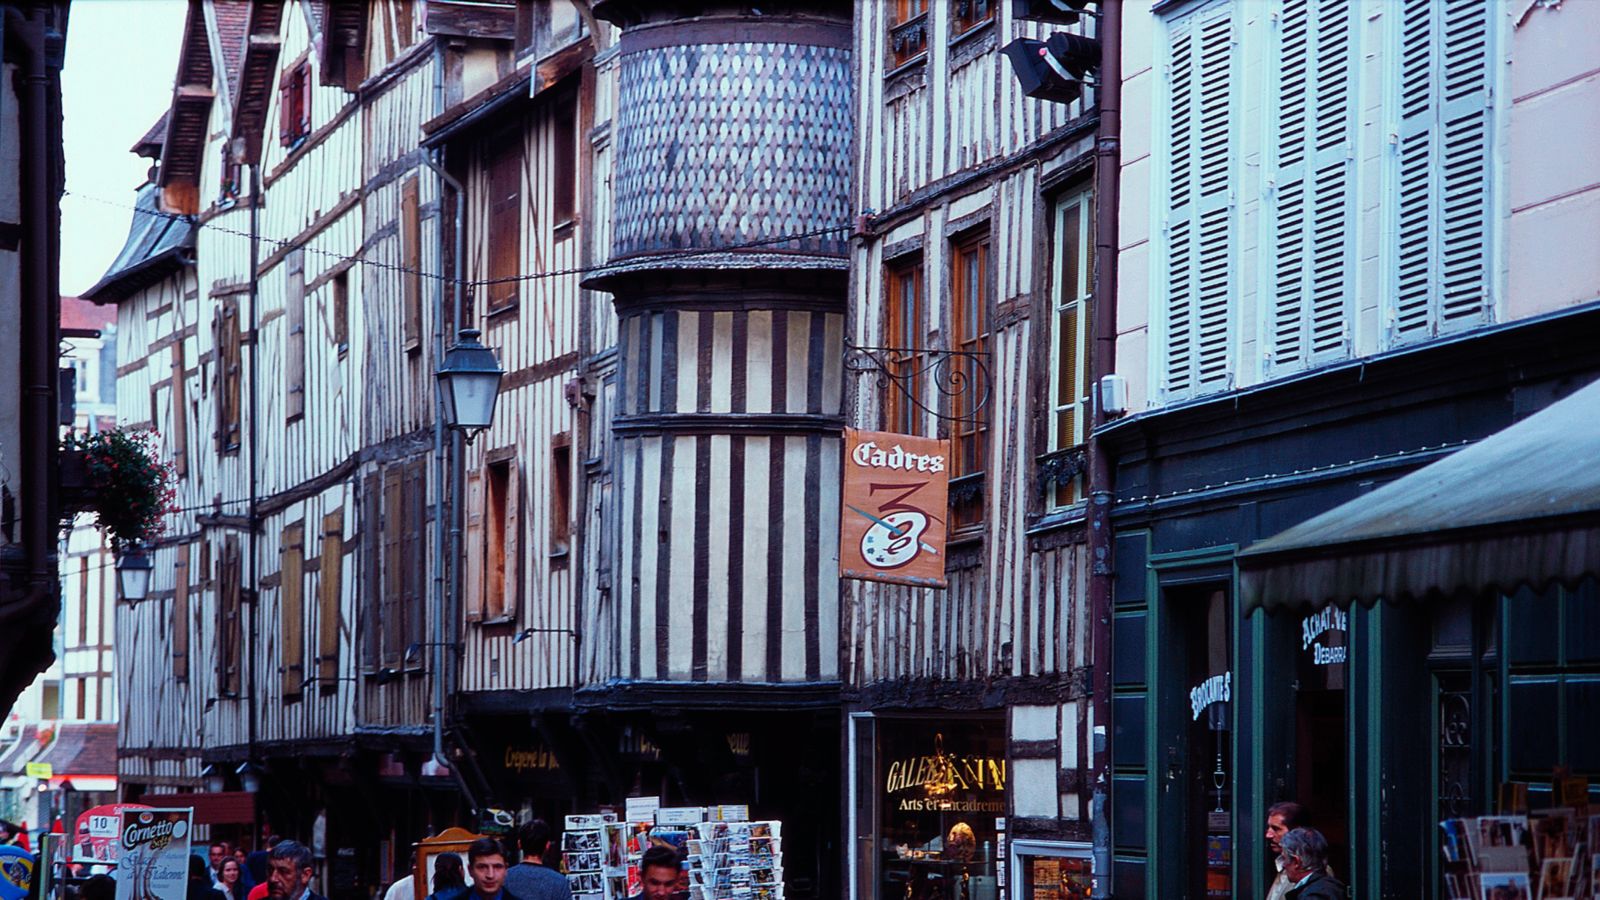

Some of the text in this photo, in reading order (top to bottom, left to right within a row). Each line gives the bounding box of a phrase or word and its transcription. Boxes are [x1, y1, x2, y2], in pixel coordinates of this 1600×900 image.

[852, 441, 945, 473] Cadres
[899, 798, 923, 811] Arts
[93, 817, 108, 829] 10
[123, 819, 173, 847] Cornetto
